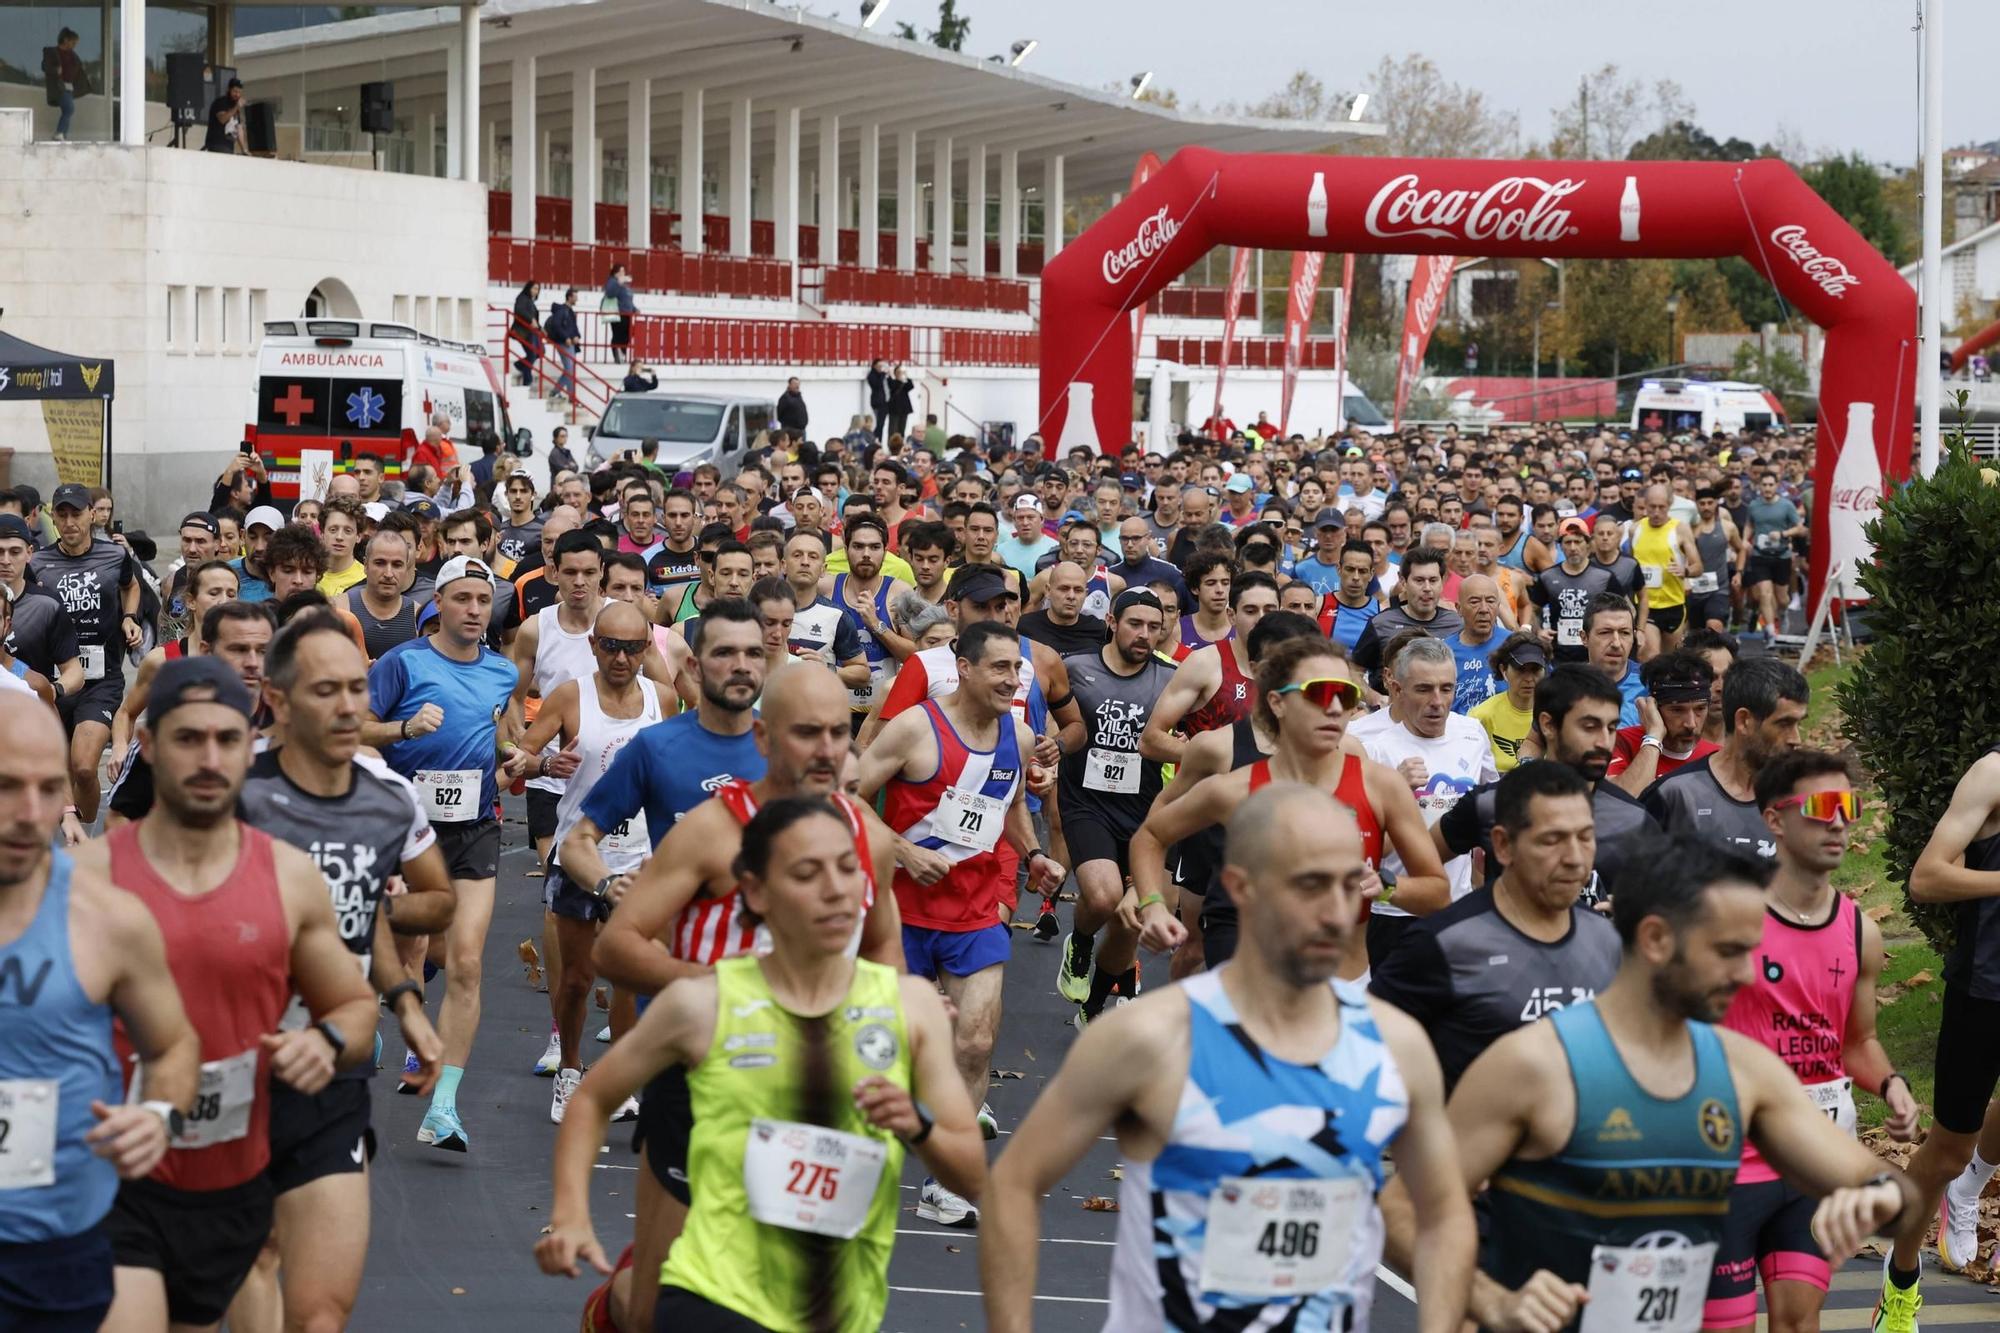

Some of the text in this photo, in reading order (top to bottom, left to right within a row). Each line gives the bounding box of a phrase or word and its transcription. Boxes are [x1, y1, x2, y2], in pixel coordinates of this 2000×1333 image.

[1365, 174, 1586, 241] Coca-Cola
[1103, 204, 1179, 285] Coca-Cola
[1771, 225, 1861, 297] Coca-Cola
[281, 353, 384, 367] AMBULANCIA
[57, 573, 82, 592] 45
[59, 588, 91, 603] VILLA
[1558, 589, 1576, 601] 45
[1463, 658, 1483, 672] edp
[1096, 699, 1125, 720] 45
[1097, 718, 1133, 736] VILLA
[991, 769, 1014, 781] Toscaf
[1104, 765, 1125, 781] 921
[435, 788, 462, 806] 522
[958, 809, 983, 832] 721
[785, 1160, 841, 1201] 275
[1257, 1221, 1320, 1258] 496
[1636, 1287, 1679, 1322] 231
